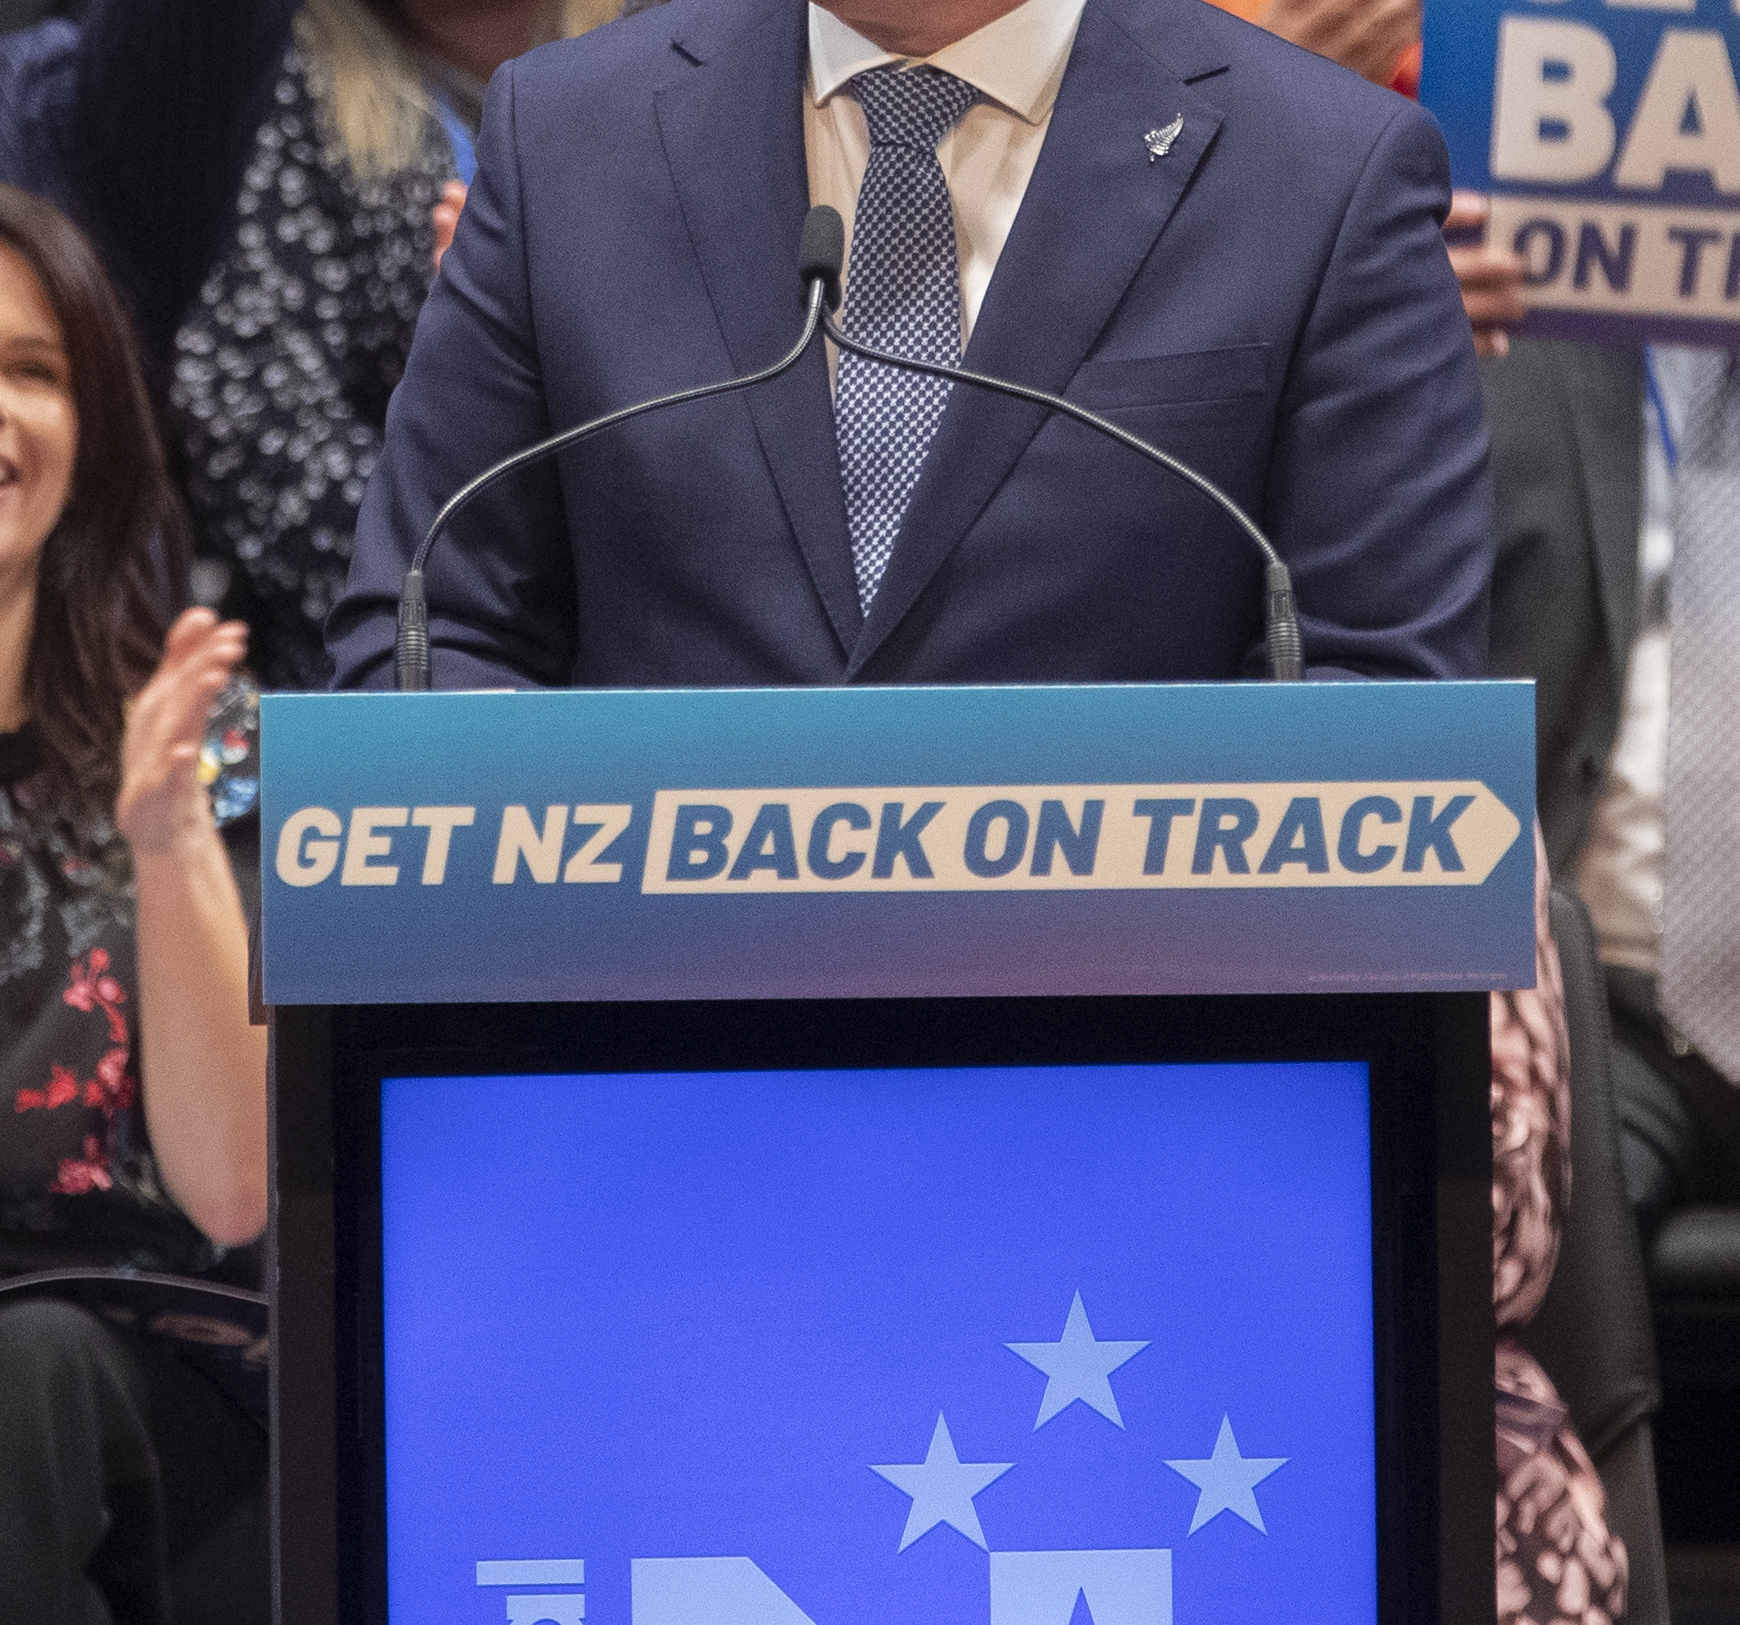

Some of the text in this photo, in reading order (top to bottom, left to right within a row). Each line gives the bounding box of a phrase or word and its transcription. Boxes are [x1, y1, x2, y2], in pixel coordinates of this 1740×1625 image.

[1519, 218, 1638, 293] ON
[275, 794, 1478, 888] GET NZ BACK ON TRACK
